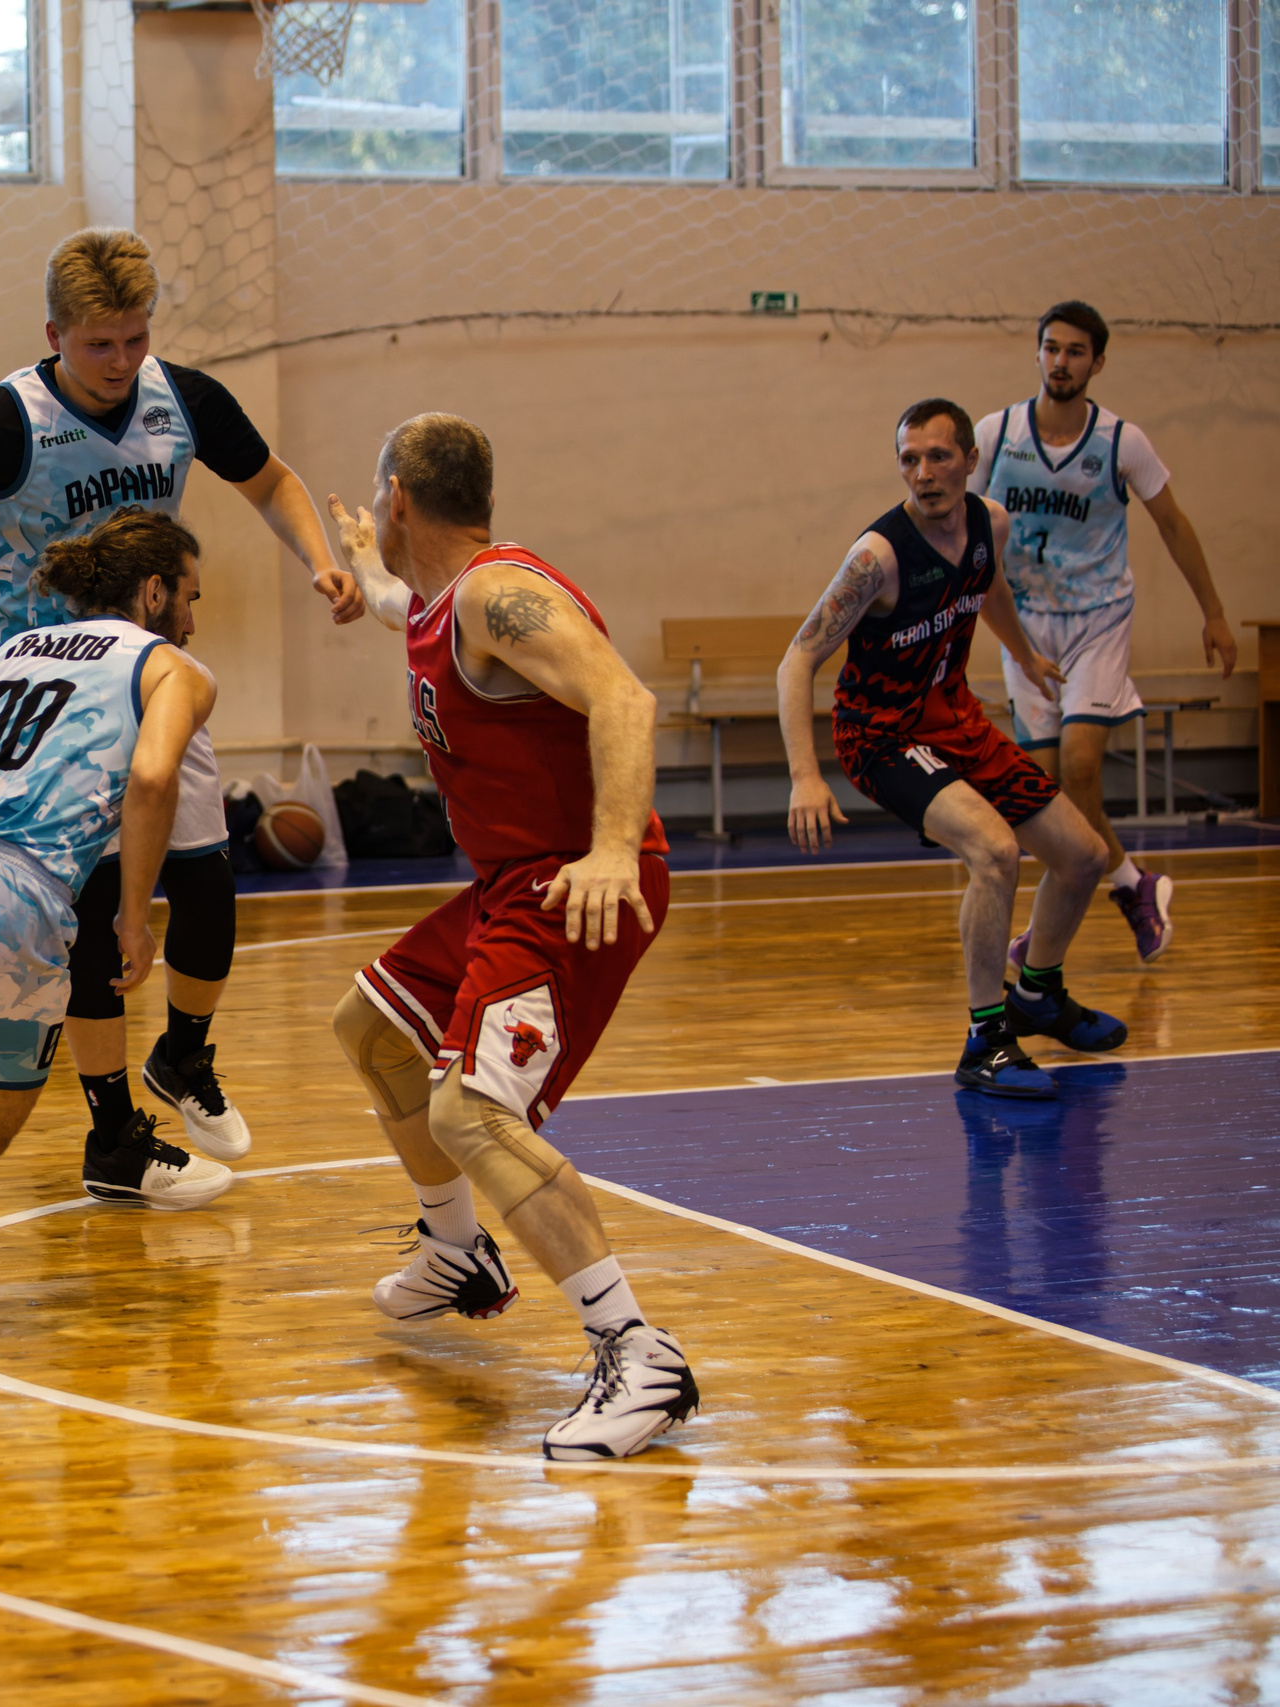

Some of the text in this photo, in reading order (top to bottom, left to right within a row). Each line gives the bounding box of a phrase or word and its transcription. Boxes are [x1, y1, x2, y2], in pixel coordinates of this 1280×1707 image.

[39, 428, 88, 449] fruitit
[65, 463, 175, 519] ВАРАНЫ
[1005, 486, 1091, 523] ВАРАНЫ
[1035, 530, 1049, 564] 7
[892, 620, 932, 649] PERM
